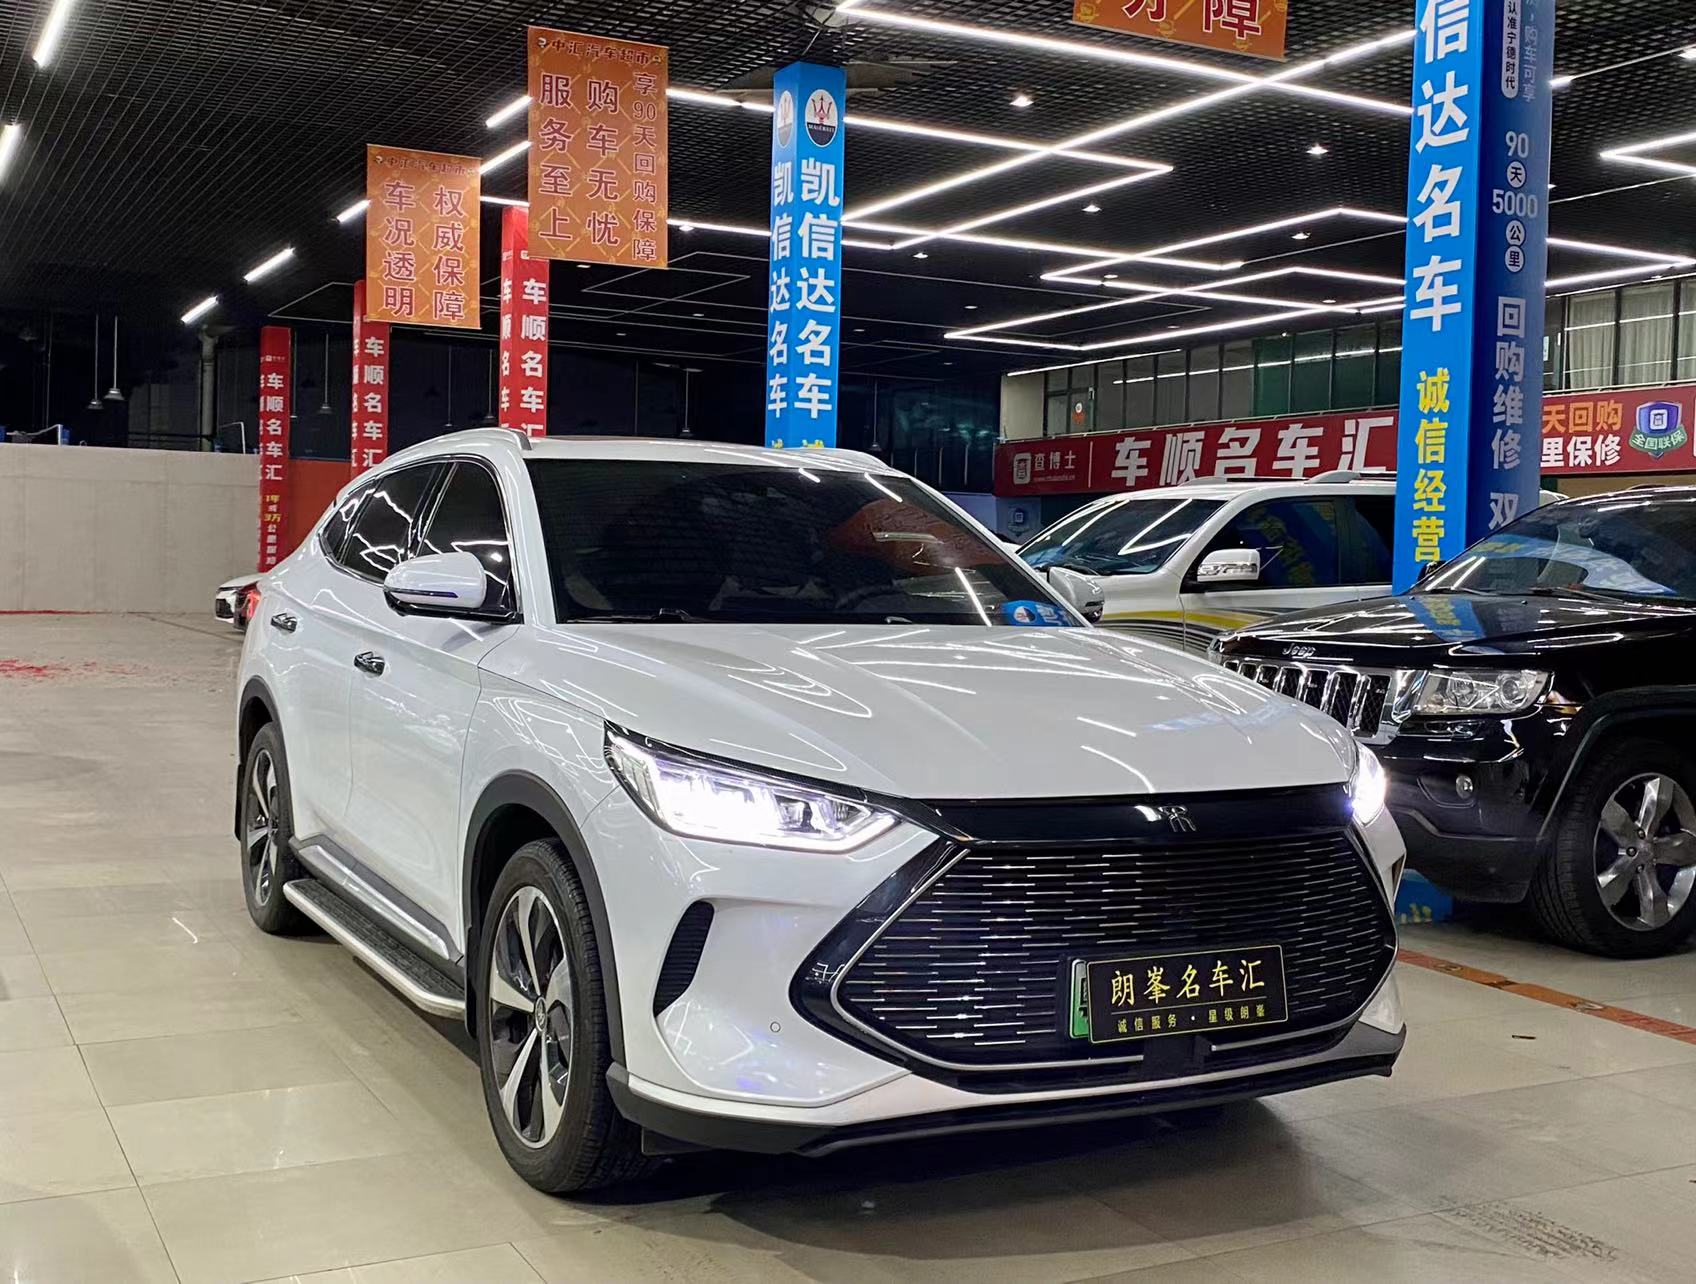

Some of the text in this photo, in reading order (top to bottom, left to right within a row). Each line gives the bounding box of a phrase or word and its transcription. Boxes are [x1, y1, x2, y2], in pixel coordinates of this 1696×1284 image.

[538, 72, 573, 242] 服务至上
[586, 79, 620, 248] 购车无忧
[632, 71, 657, 262] 享90天回购保障
[384, 180, 416, 318] 车况透明
[432, 186, 464, 322] 权威保障
[768, 160, 795, 418] 凯信达名车
[793, 156, 841, 419] 凯信达名车
[265, 373, 284, 480] 车顺名车汇
[362, 336, 385, 468] 车顺名车汇
[1034, 450, 1077, 471] 查博士
[1109, 416, 1394, 487] 车顺名车汇
[1491, 296, 1527, 470] 回购维修
[1540, 433, 1621, 468] 里保修
[1541, 399, 1623, 434] 天回购
[1631, 430, 1686, 450] 全国联保
[1413, 367, 1450, 563] 诚信经营
[1281, 642, 1317, 659] Jeep
